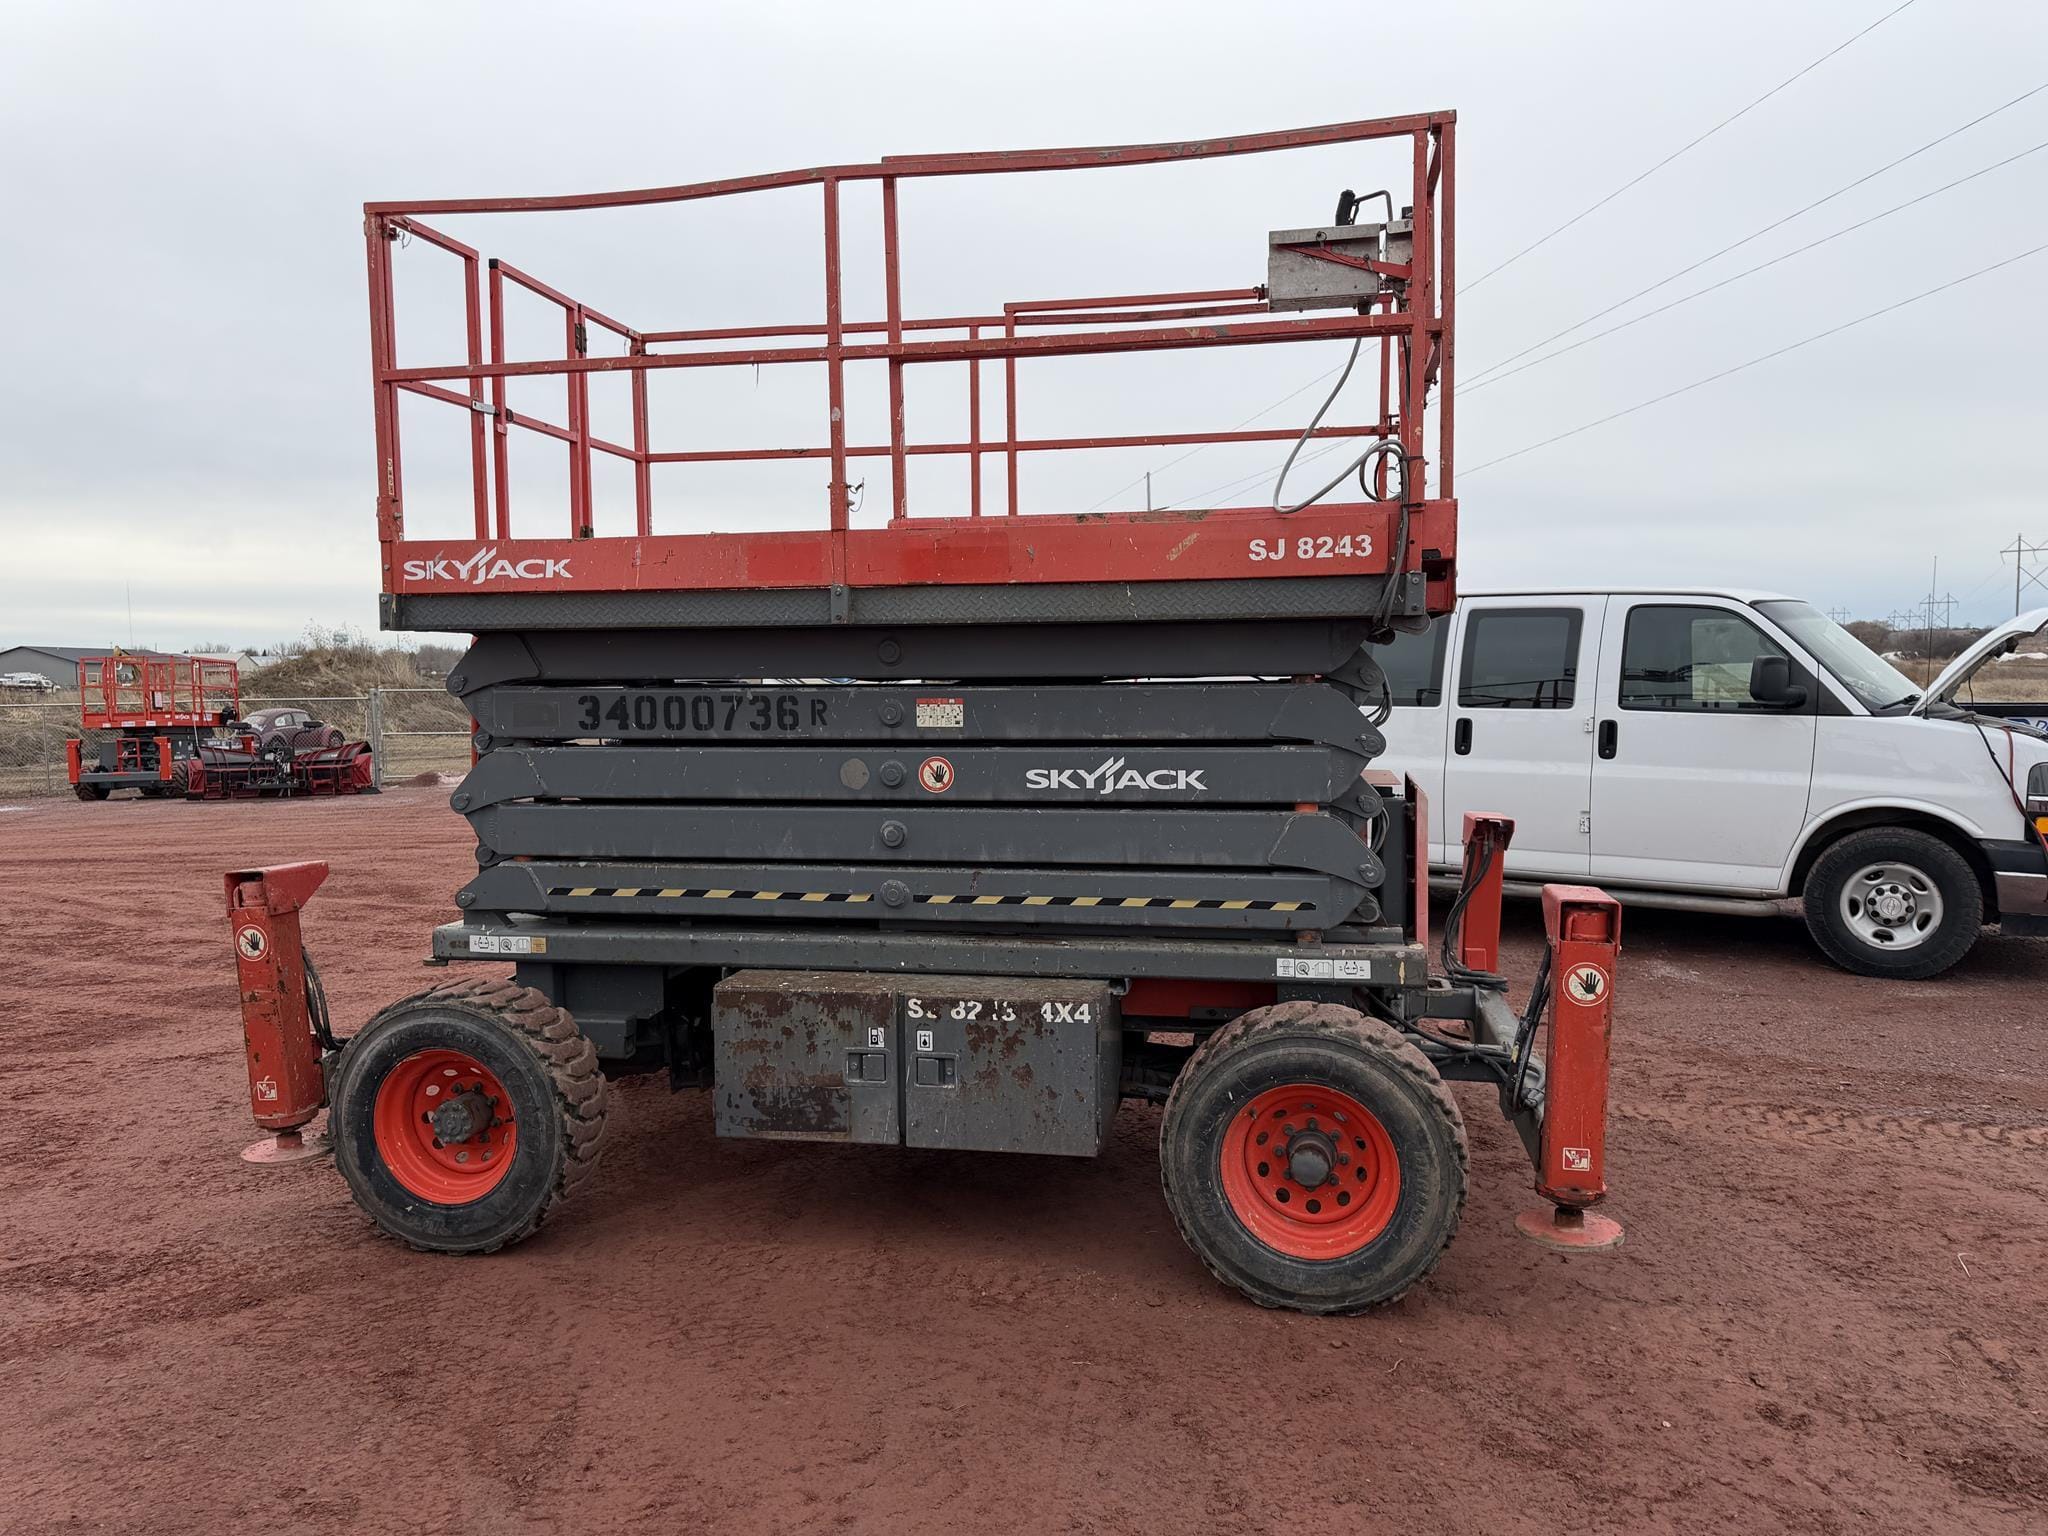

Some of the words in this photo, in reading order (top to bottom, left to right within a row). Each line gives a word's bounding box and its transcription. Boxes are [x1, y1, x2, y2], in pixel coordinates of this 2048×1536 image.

[403, 546, 574, 585] SKYJACK
[1248, 538, 1286, 561] SJ
[1296, 534, 1374, 559] 8243
[578, 695, 800, 732] 34000736
[1025, 756, 1209, 795] SKYJACK
[1041, 1002, 1092, 1024] 4X4
